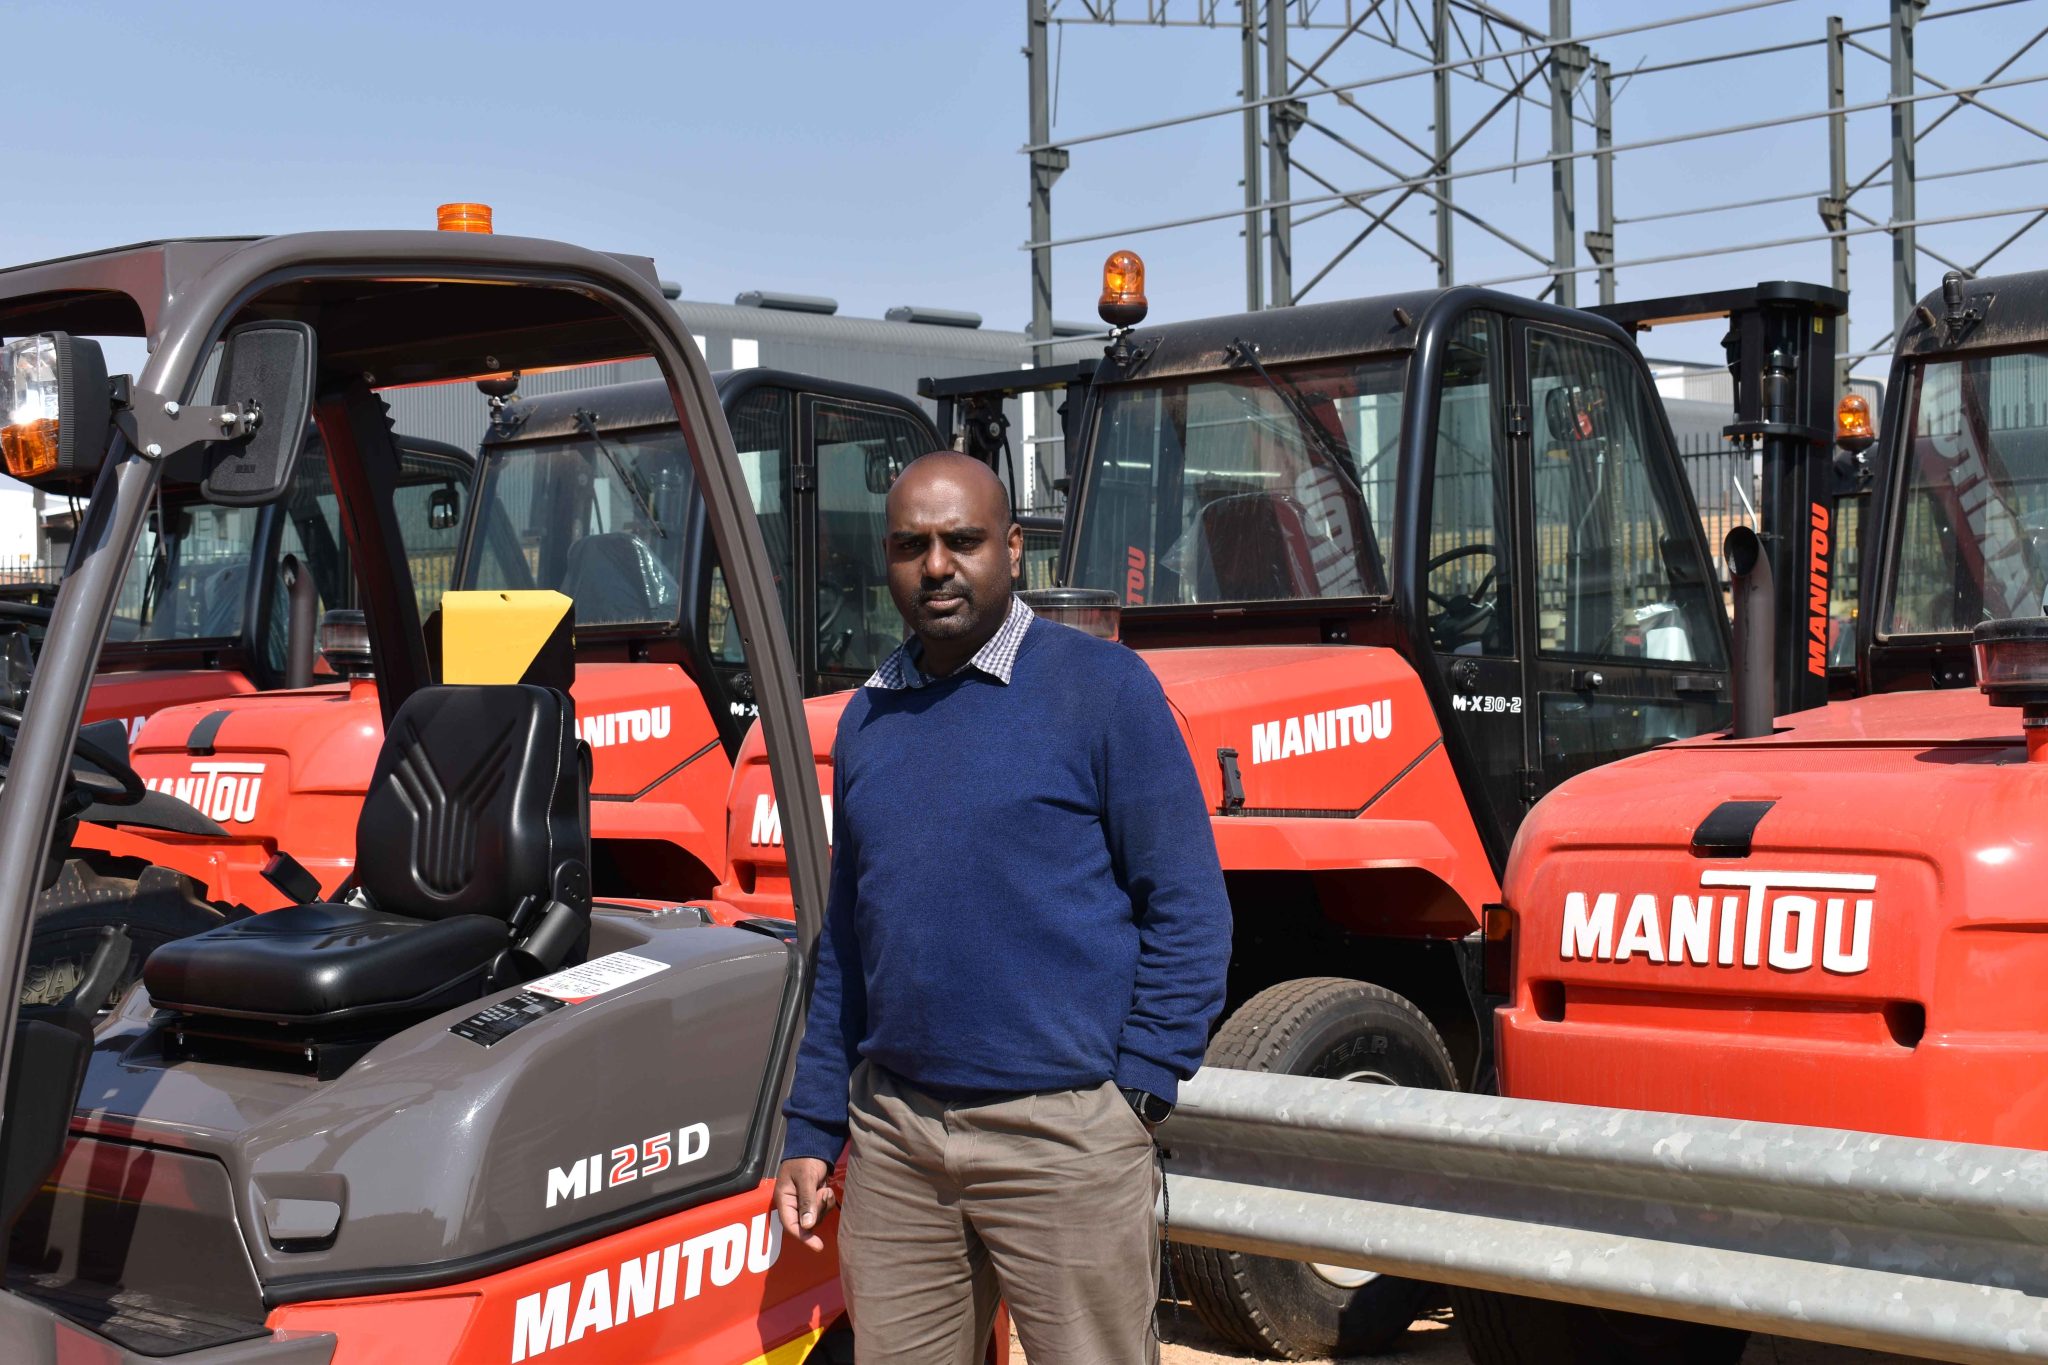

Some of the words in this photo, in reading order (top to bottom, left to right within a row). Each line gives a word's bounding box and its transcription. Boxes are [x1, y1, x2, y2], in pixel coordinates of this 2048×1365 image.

[1808, 502, 1829, 677] MANITOU
[575, 706, 670, 748] NITOU
[1252, 699, 1392, 764] MANITOU
[1561, 870, 1877, 973] MANITOU
[511, 1209, 784, 1364] MANITOU
